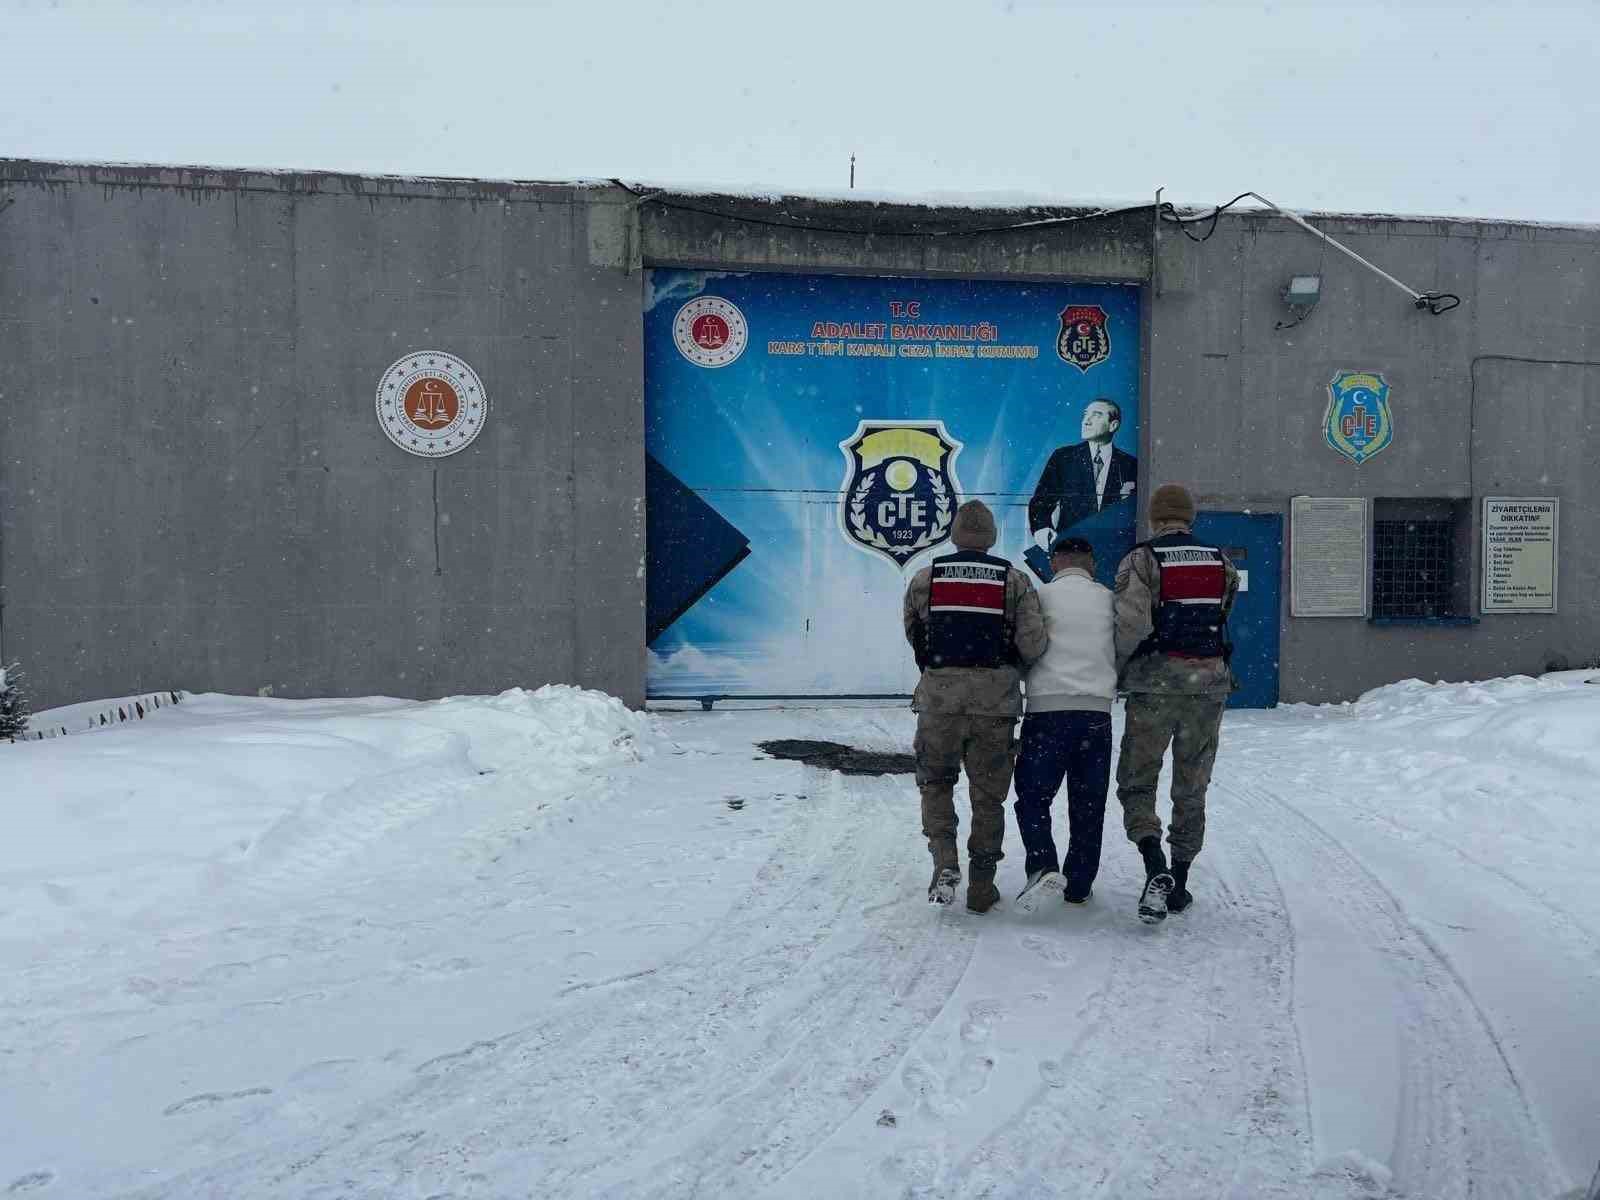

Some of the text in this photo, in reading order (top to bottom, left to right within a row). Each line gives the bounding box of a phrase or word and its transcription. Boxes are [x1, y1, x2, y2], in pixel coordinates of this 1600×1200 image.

[811, 321, 998, 341] ADALET BAKANLIĞI
[767, 341, 806, 355] KARS
[807, 342, 816, 356] T
[817, 339, 844, 356] TİPİ
[847, 343, 896, 357] KAPALI
[898, 344, 933, 358] CEZA
[1073, 336, 1095, 353] CTE
[1341, 406, 1377, 438] CTE
[878, 493, 926, 528] CTE
[893, 530, 913, 539] 1923
[1164, 551, 1216, 561] JANDARMA
[942, 565, 998, 579] JANDARMA
